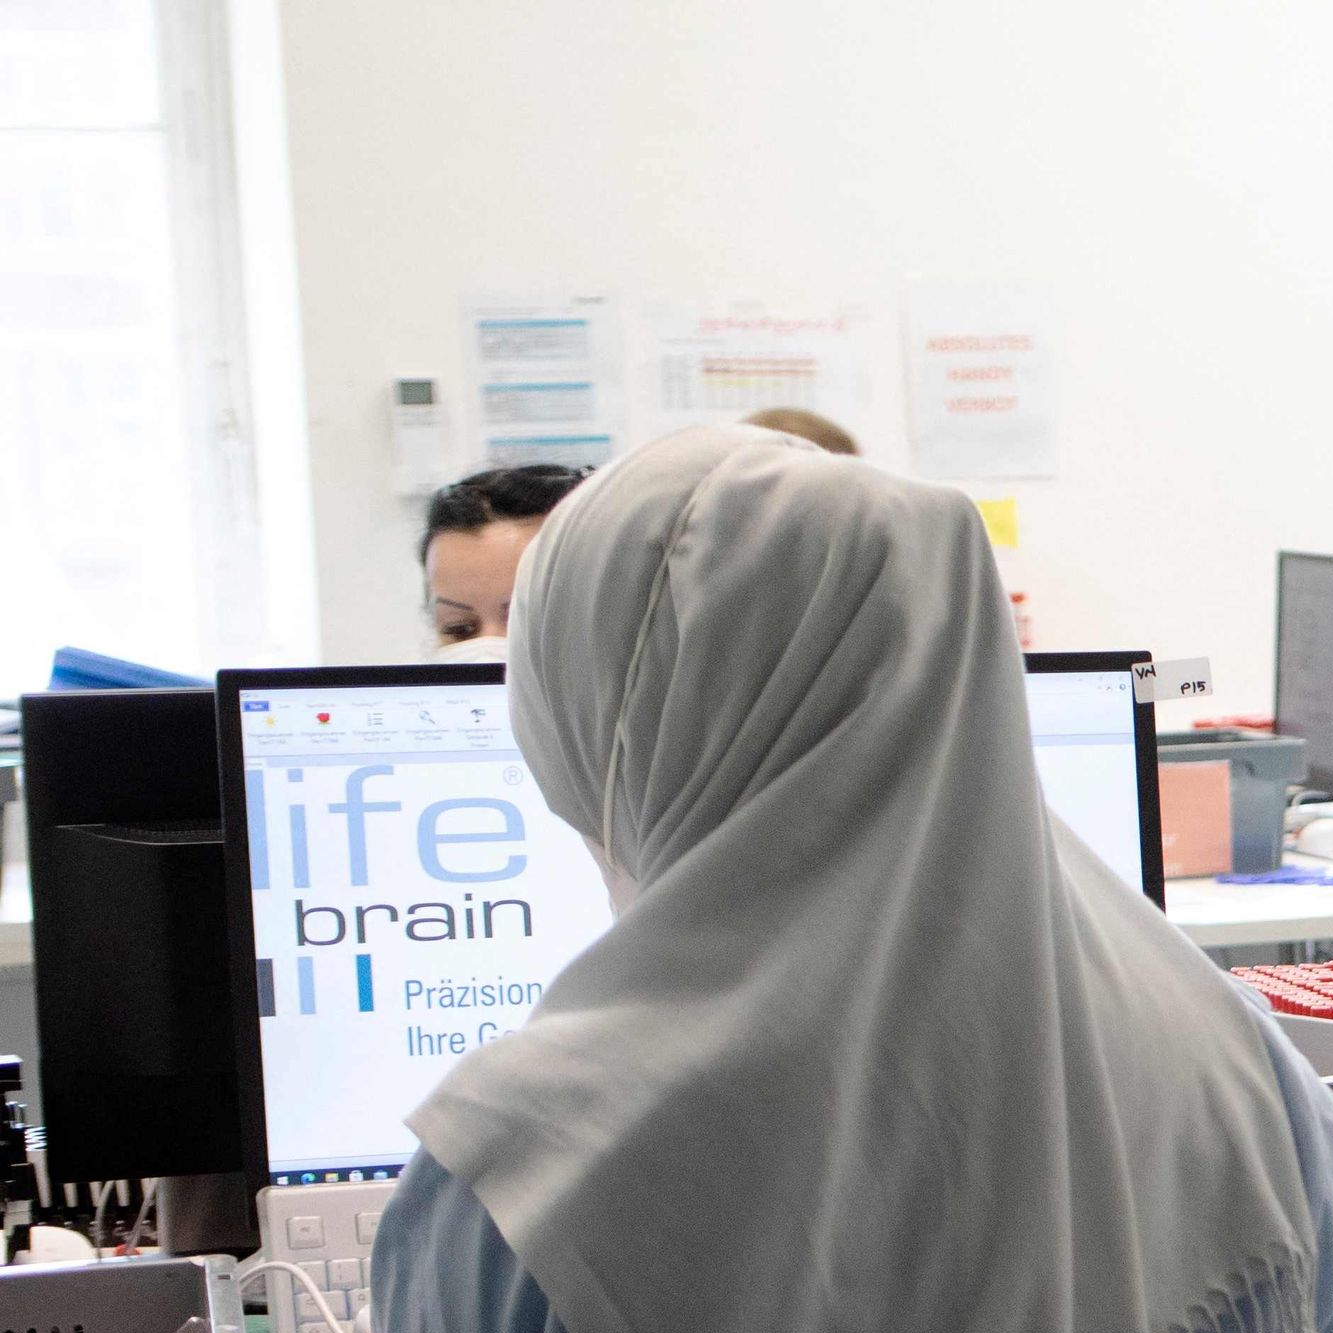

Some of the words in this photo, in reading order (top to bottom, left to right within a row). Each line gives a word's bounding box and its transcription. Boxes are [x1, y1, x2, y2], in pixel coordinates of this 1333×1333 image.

[1180, 681, 1207, 695] P15
[245, 763, 528, 890] life
[295, 892, 534, 947] brain
[404, 975, 543, 1011] Präzision
[407, 1025, 466, 1057] Ihre
